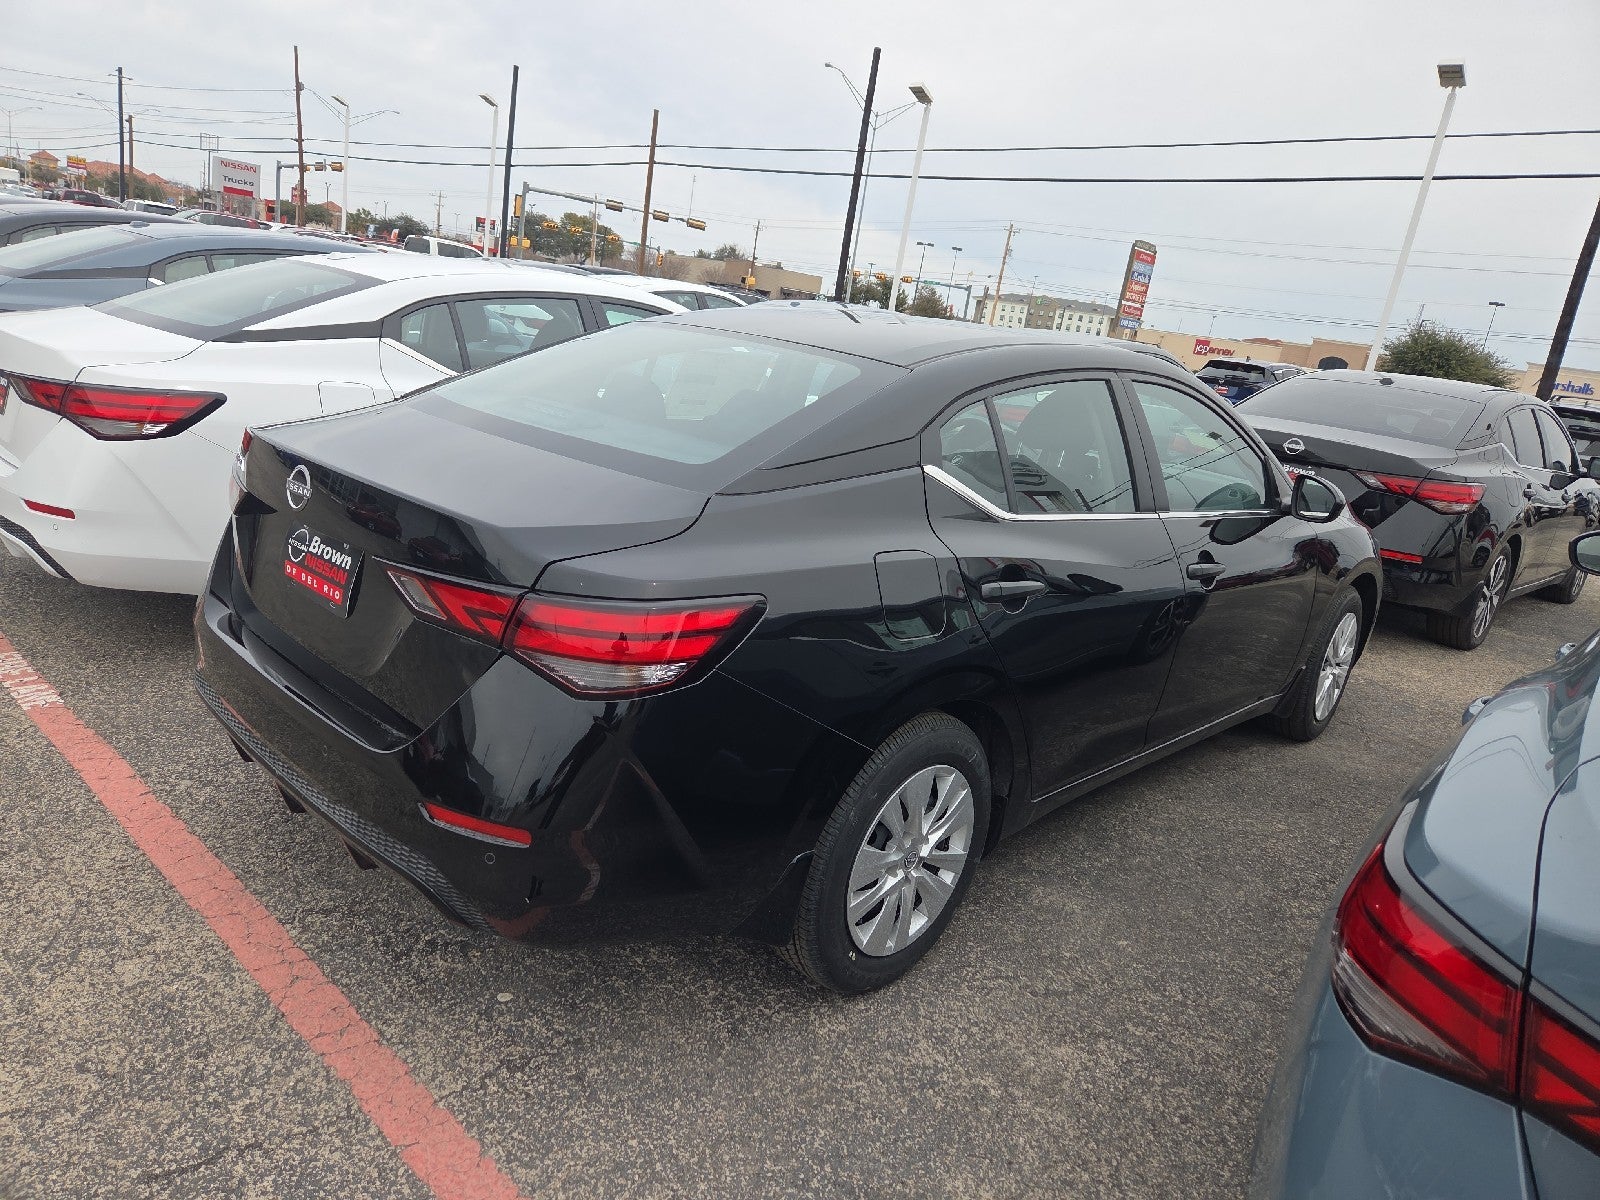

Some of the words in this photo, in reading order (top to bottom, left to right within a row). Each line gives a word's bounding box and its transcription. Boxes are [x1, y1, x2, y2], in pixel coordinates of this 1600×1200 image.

[220, 160, 257, 173] NISSAN
[222, 175, 254, 187] Trucks
[1554, 380, 1595, 395] rshalls
[1283, 464, 1316, 476] Brown
[288, 482, 311, 497] SSAN
[288, 537, 309, 552] NISSAN
[309, 535, 352, 570] Brown
[305, 552, 348, 585] NISSAN
[286, 564, 297, 576] OF
[301, 572, 318, 588] DEL
[323, 584, 340, 600] RIO
